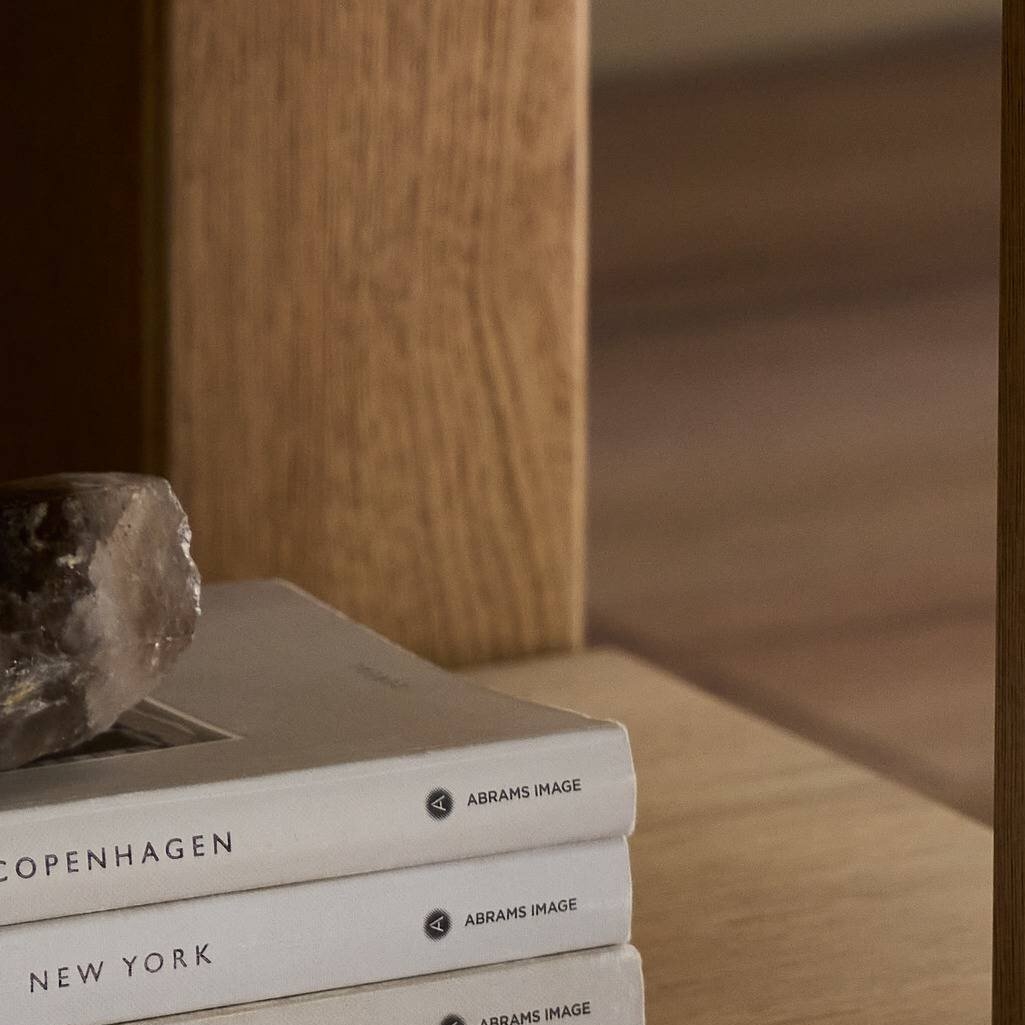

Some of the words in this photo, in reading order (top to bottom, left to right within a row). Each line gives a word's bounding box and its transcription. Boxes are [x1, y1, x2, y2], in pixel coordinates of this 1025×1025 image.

[468, 786, 530, 807] ABRAMS
[535, 779, 582, 798] IMAGE
[465, 906, 527, 927] ABRAMS
[532, 898, 578, 917] IMAGE
[30, 961, 103, 993] NEW
[122, 944, 211, 977] YORK
[545, 1001, 592, 1022] IMAGE
